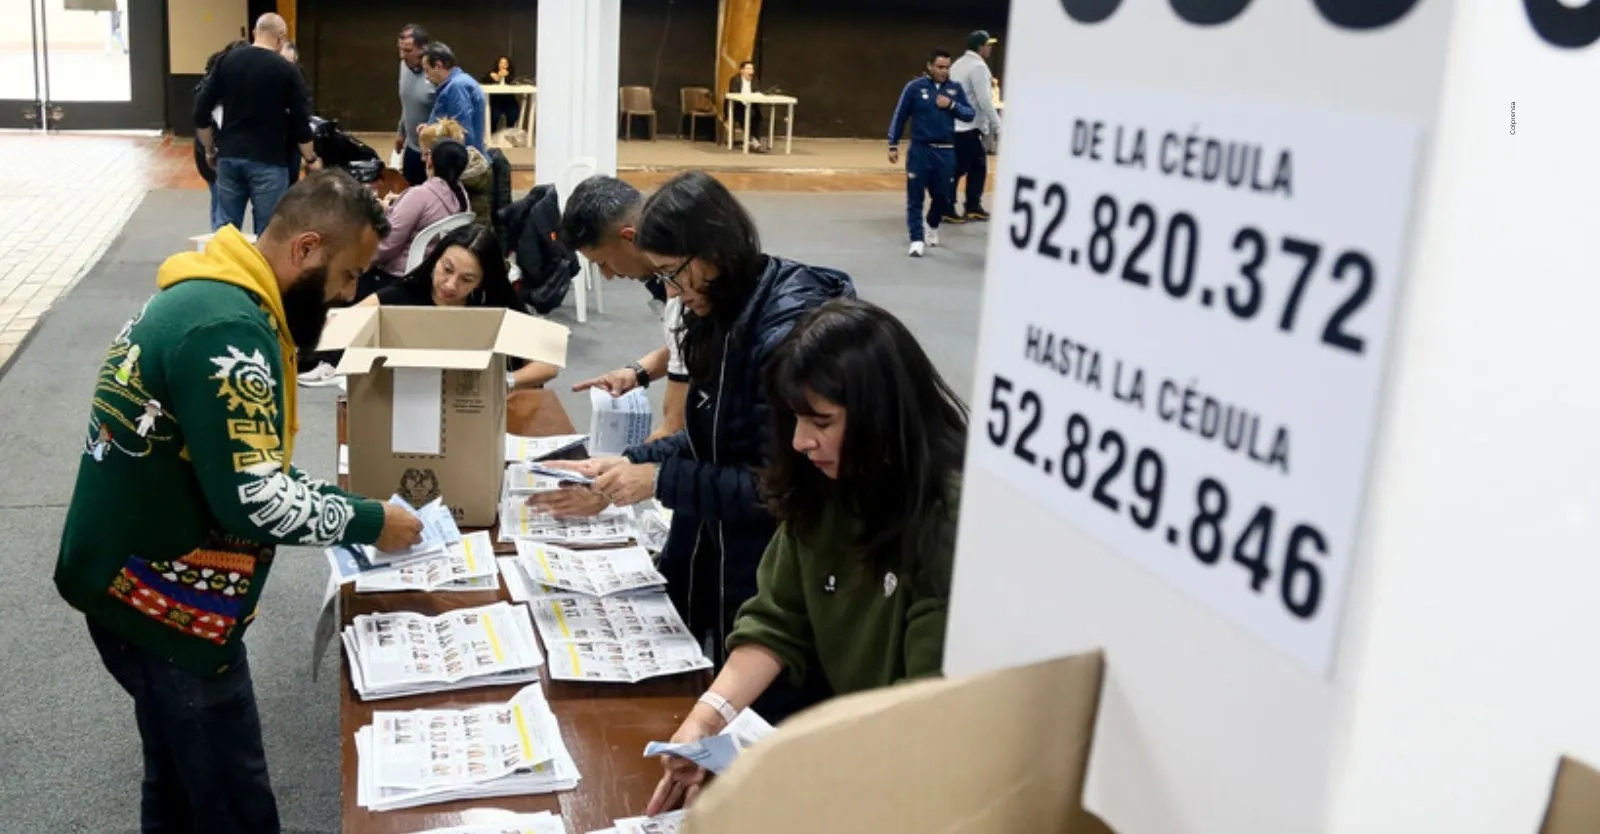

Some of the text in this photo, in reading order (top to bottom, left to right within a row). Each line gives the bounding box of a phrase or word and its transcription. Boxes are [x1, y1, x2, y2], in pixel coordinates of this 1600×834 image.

[1071, 118, 1293, 197] DE LA CÉDULA
[1009, 174, 1378, 357] 52.820.372
[1025, 325, 1290, 475] HASTA LA CÉDULA
[986, 374, 1330, 622] 52.829.846
